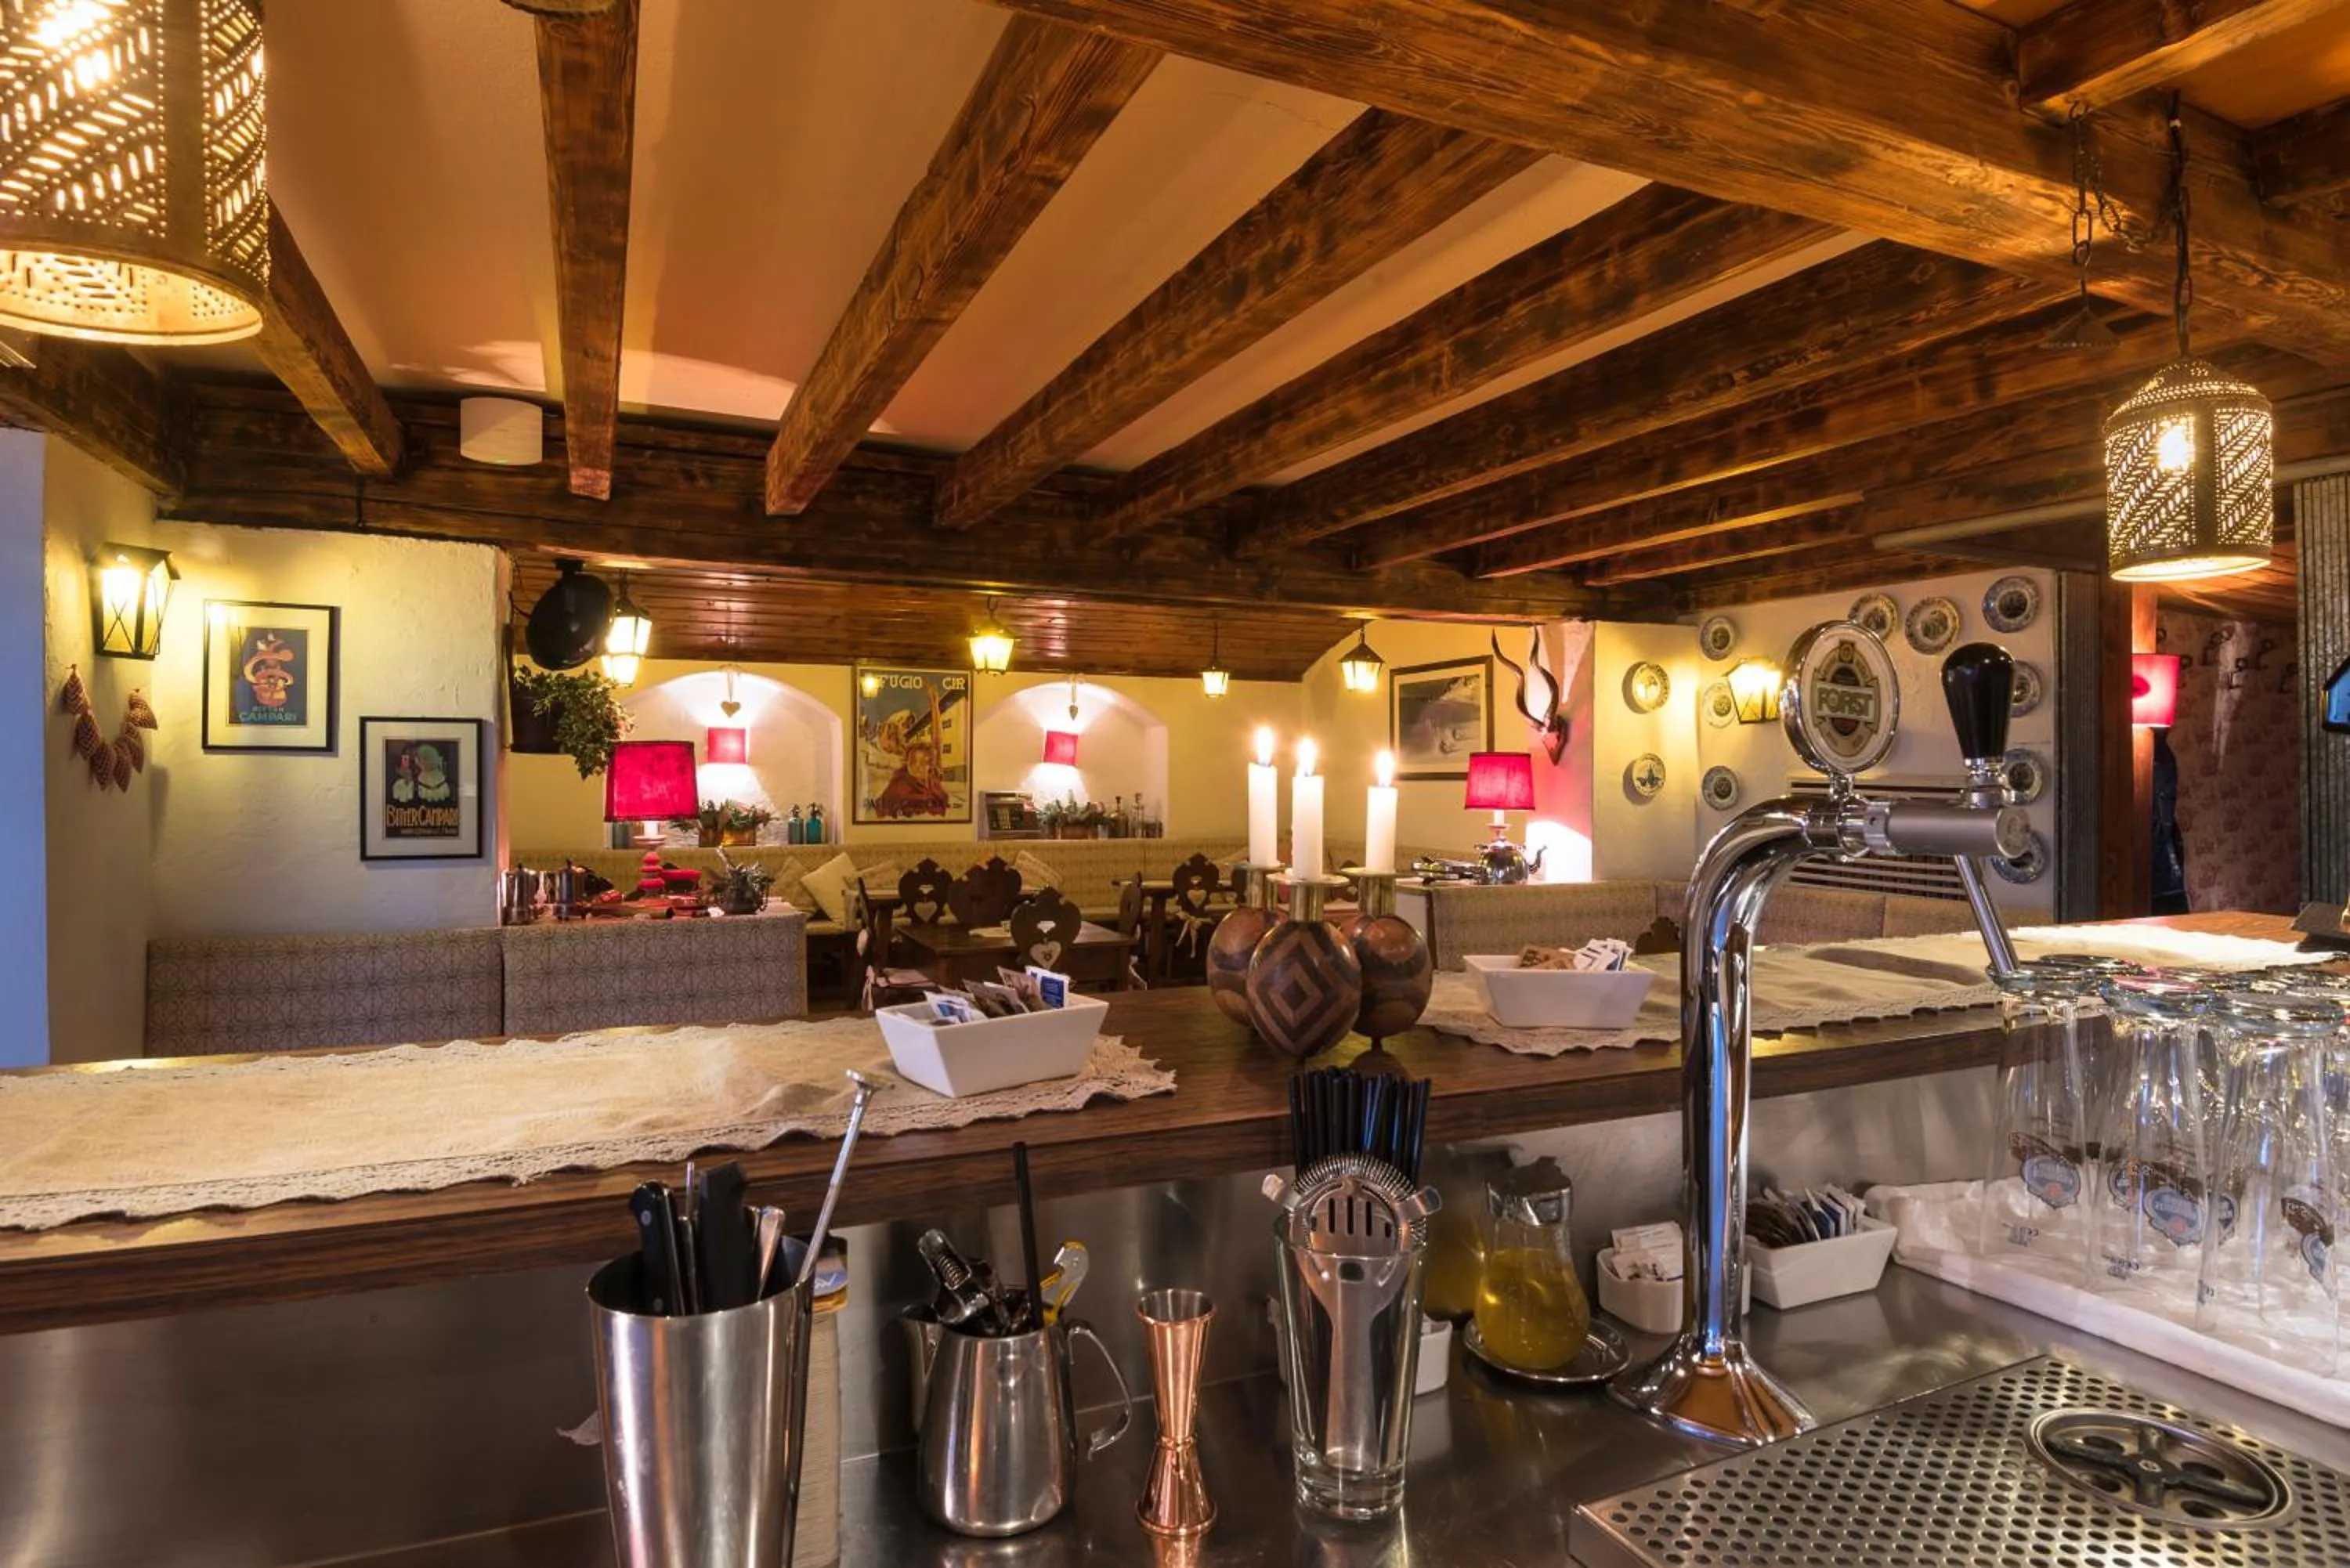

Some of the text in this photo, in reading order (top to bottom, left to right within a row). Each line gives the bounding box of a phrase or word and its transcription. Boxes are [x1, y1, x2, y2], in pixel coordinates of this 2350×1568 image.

[863, 675, 965, 690] FUGIO CIR
[1818, 687, 1873, 717] FORST
[239, 711, 297, 721] CAMPARI
